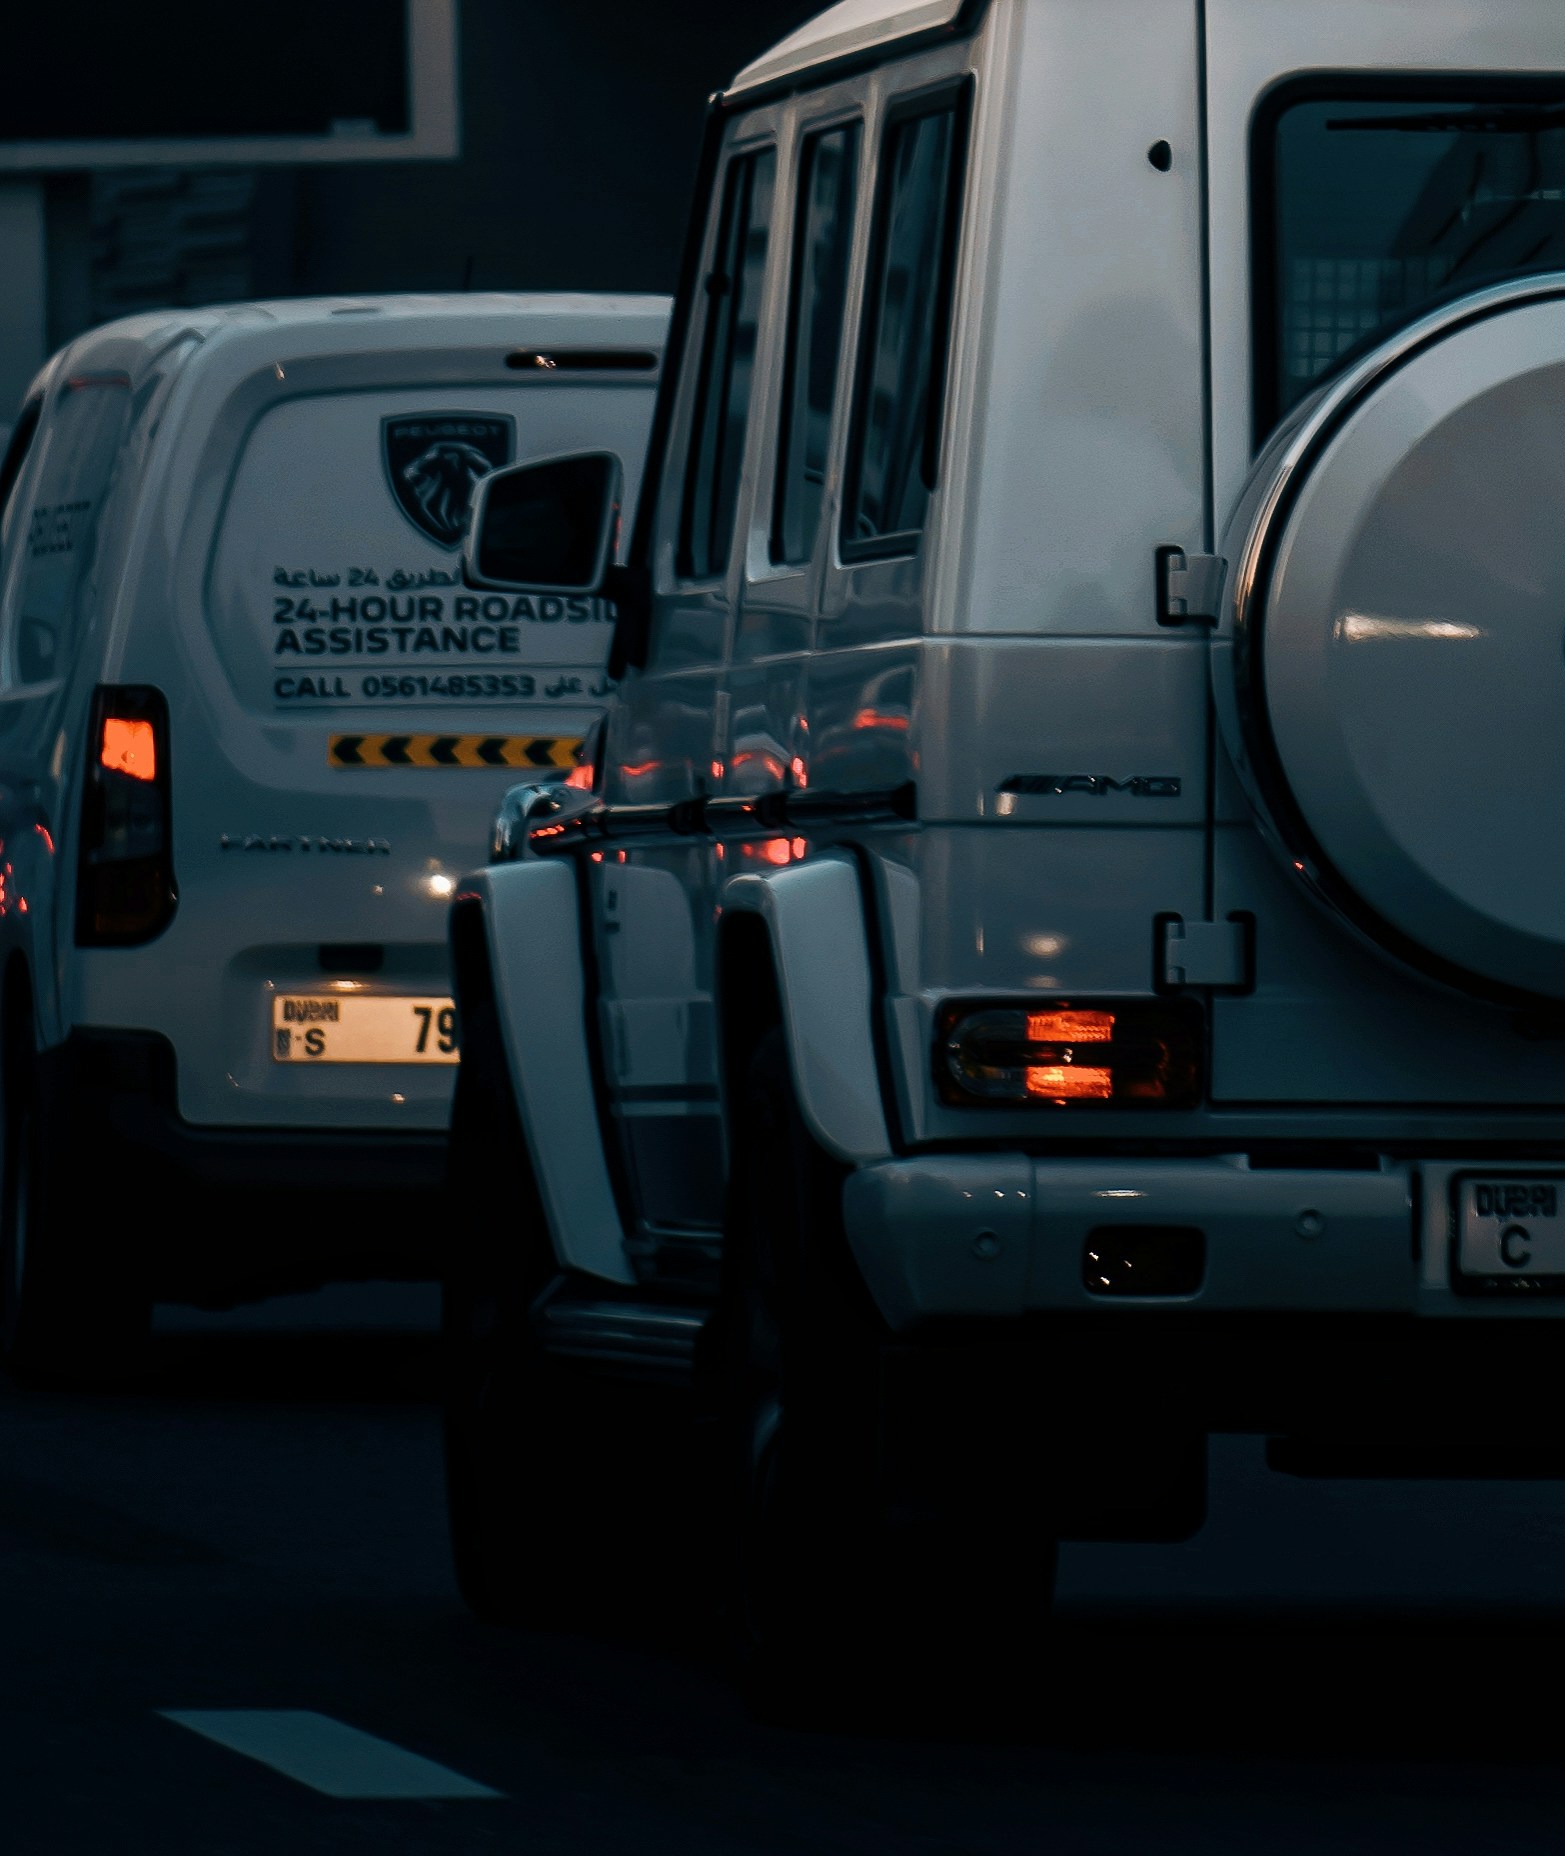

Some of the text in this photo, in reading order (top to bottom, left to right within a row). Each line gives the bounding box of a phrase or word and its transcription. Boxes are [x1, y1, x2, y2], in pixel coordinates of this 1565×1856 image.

[273, 596, 443, 623] 24-HOUR
[274, 626, 521, 654] ASSISTANCE
[274, 675, 536, 698] CALL 0561485353
[304, 1026, 326, 1056] S
[1501, 1224, 1532, 1268] C
